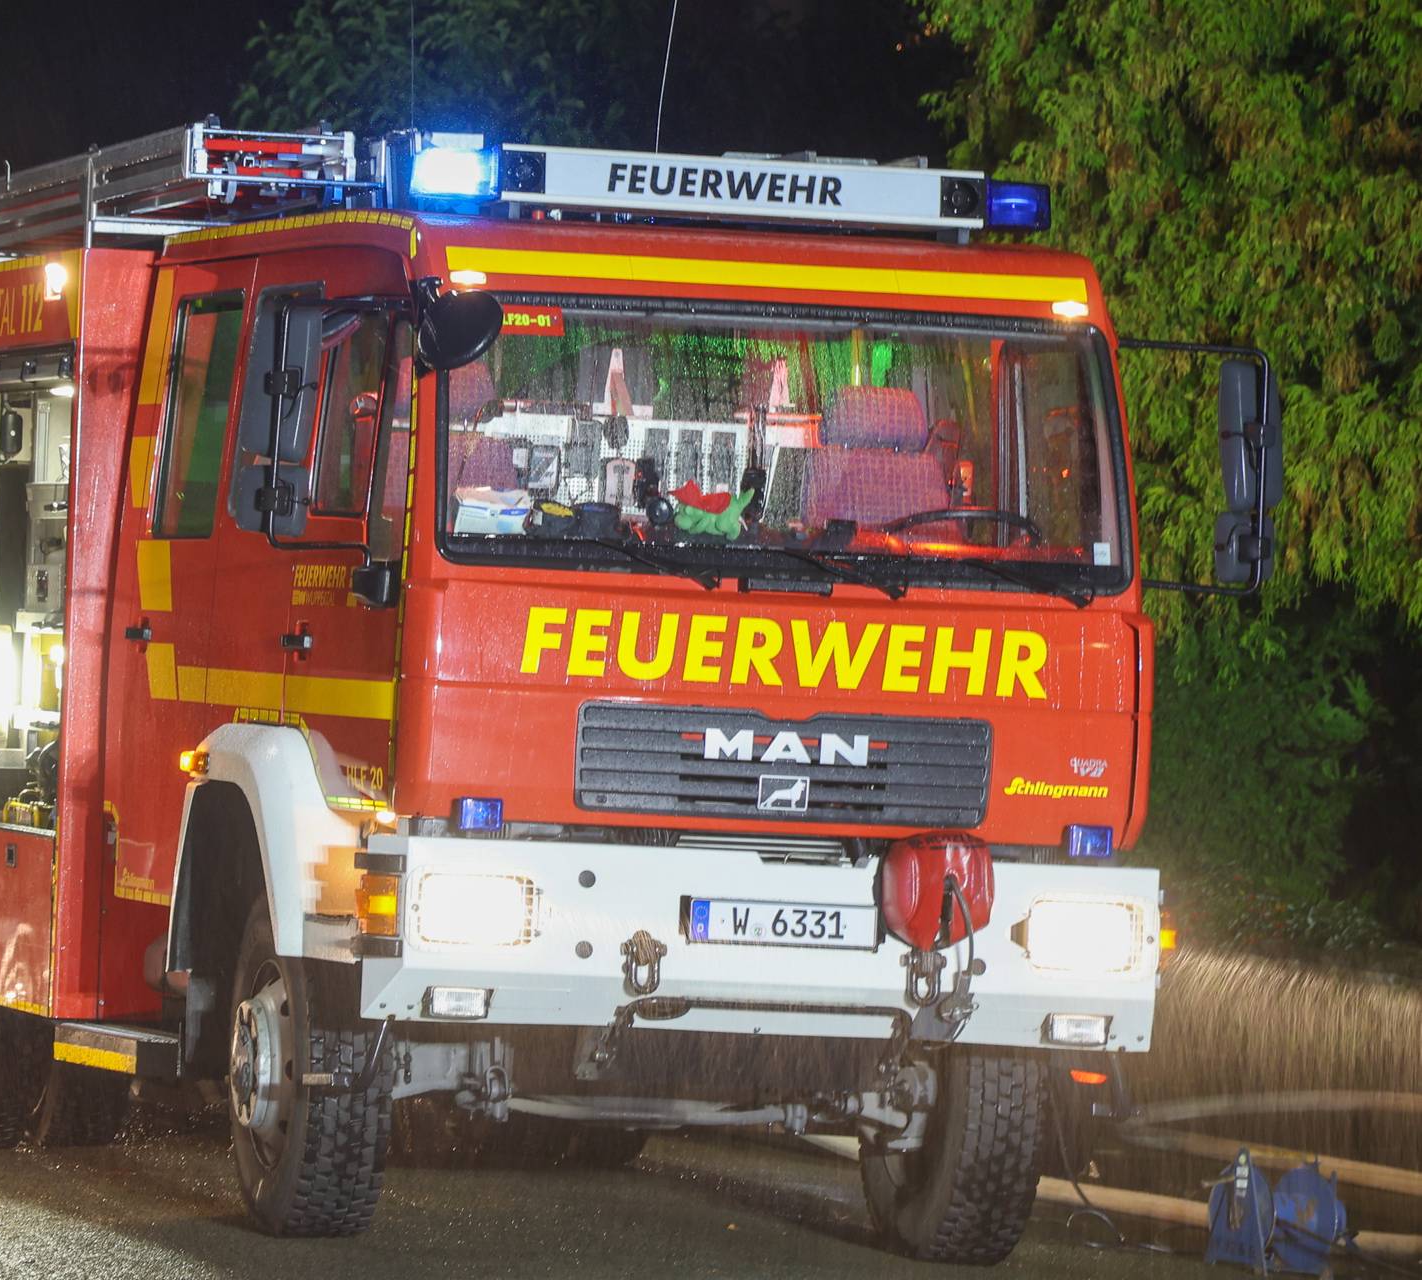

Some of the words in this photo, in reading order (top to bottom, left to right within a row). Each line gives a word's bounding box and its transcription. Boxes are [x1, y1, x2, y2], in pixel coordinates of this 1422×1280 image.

[607, 162, 842, 207] FEUERWEHR
[20, 282, 45, 334] 112
[293, 564, 346, 589] FEUERWEHR
[519, 606, 1049, 699] FEUERWEHR
[703, 727, 870, 767] MAN
[370, 765, 384, 790] 20
[1004, 776, 1109, 799] Schlingmann
[732, 907, 750, 936] W
[771, 908, 844, 940] 6331
